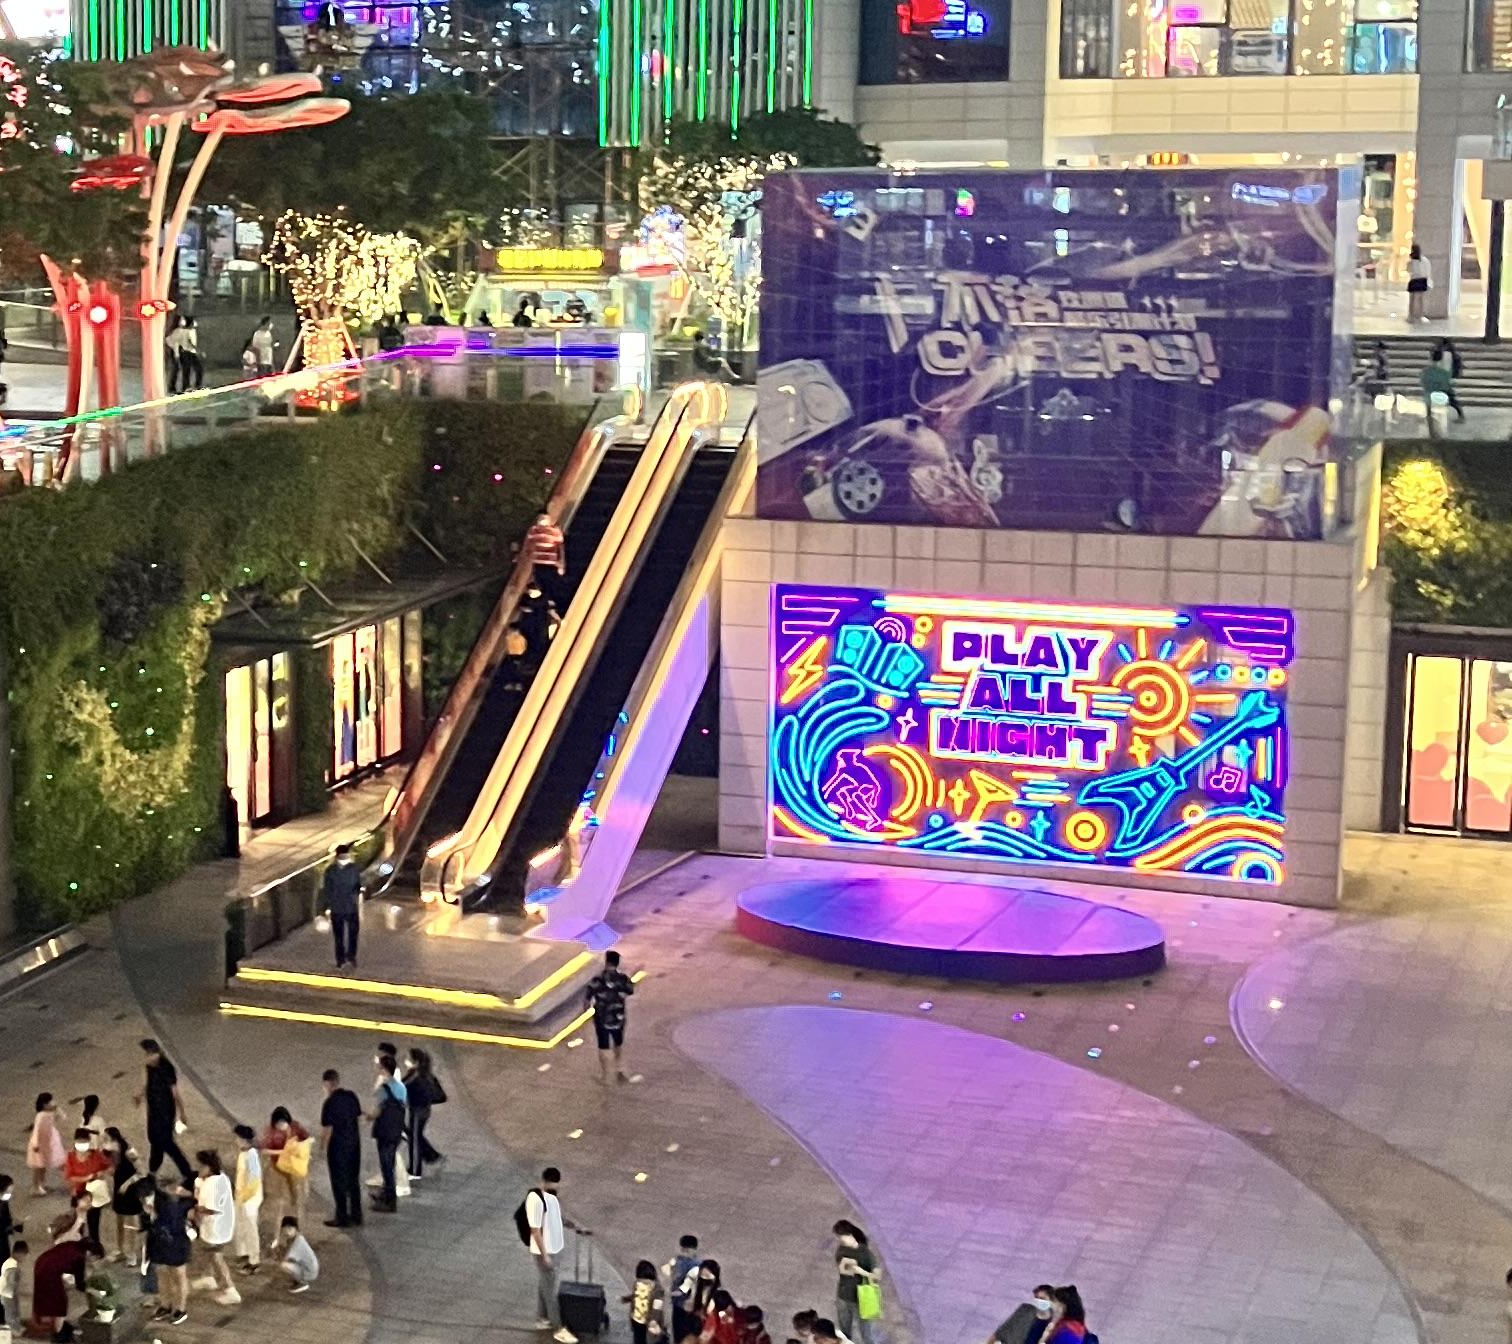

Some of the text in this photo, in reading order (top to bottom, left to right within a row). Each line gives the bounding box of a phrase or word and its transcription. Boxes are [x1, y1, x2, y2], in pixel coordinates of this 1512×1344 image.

[951, 630, 1101, 672] PLAY
[968, 676, 1078, 716] ALL
[936, 715, 1109, 764] NIGHT
